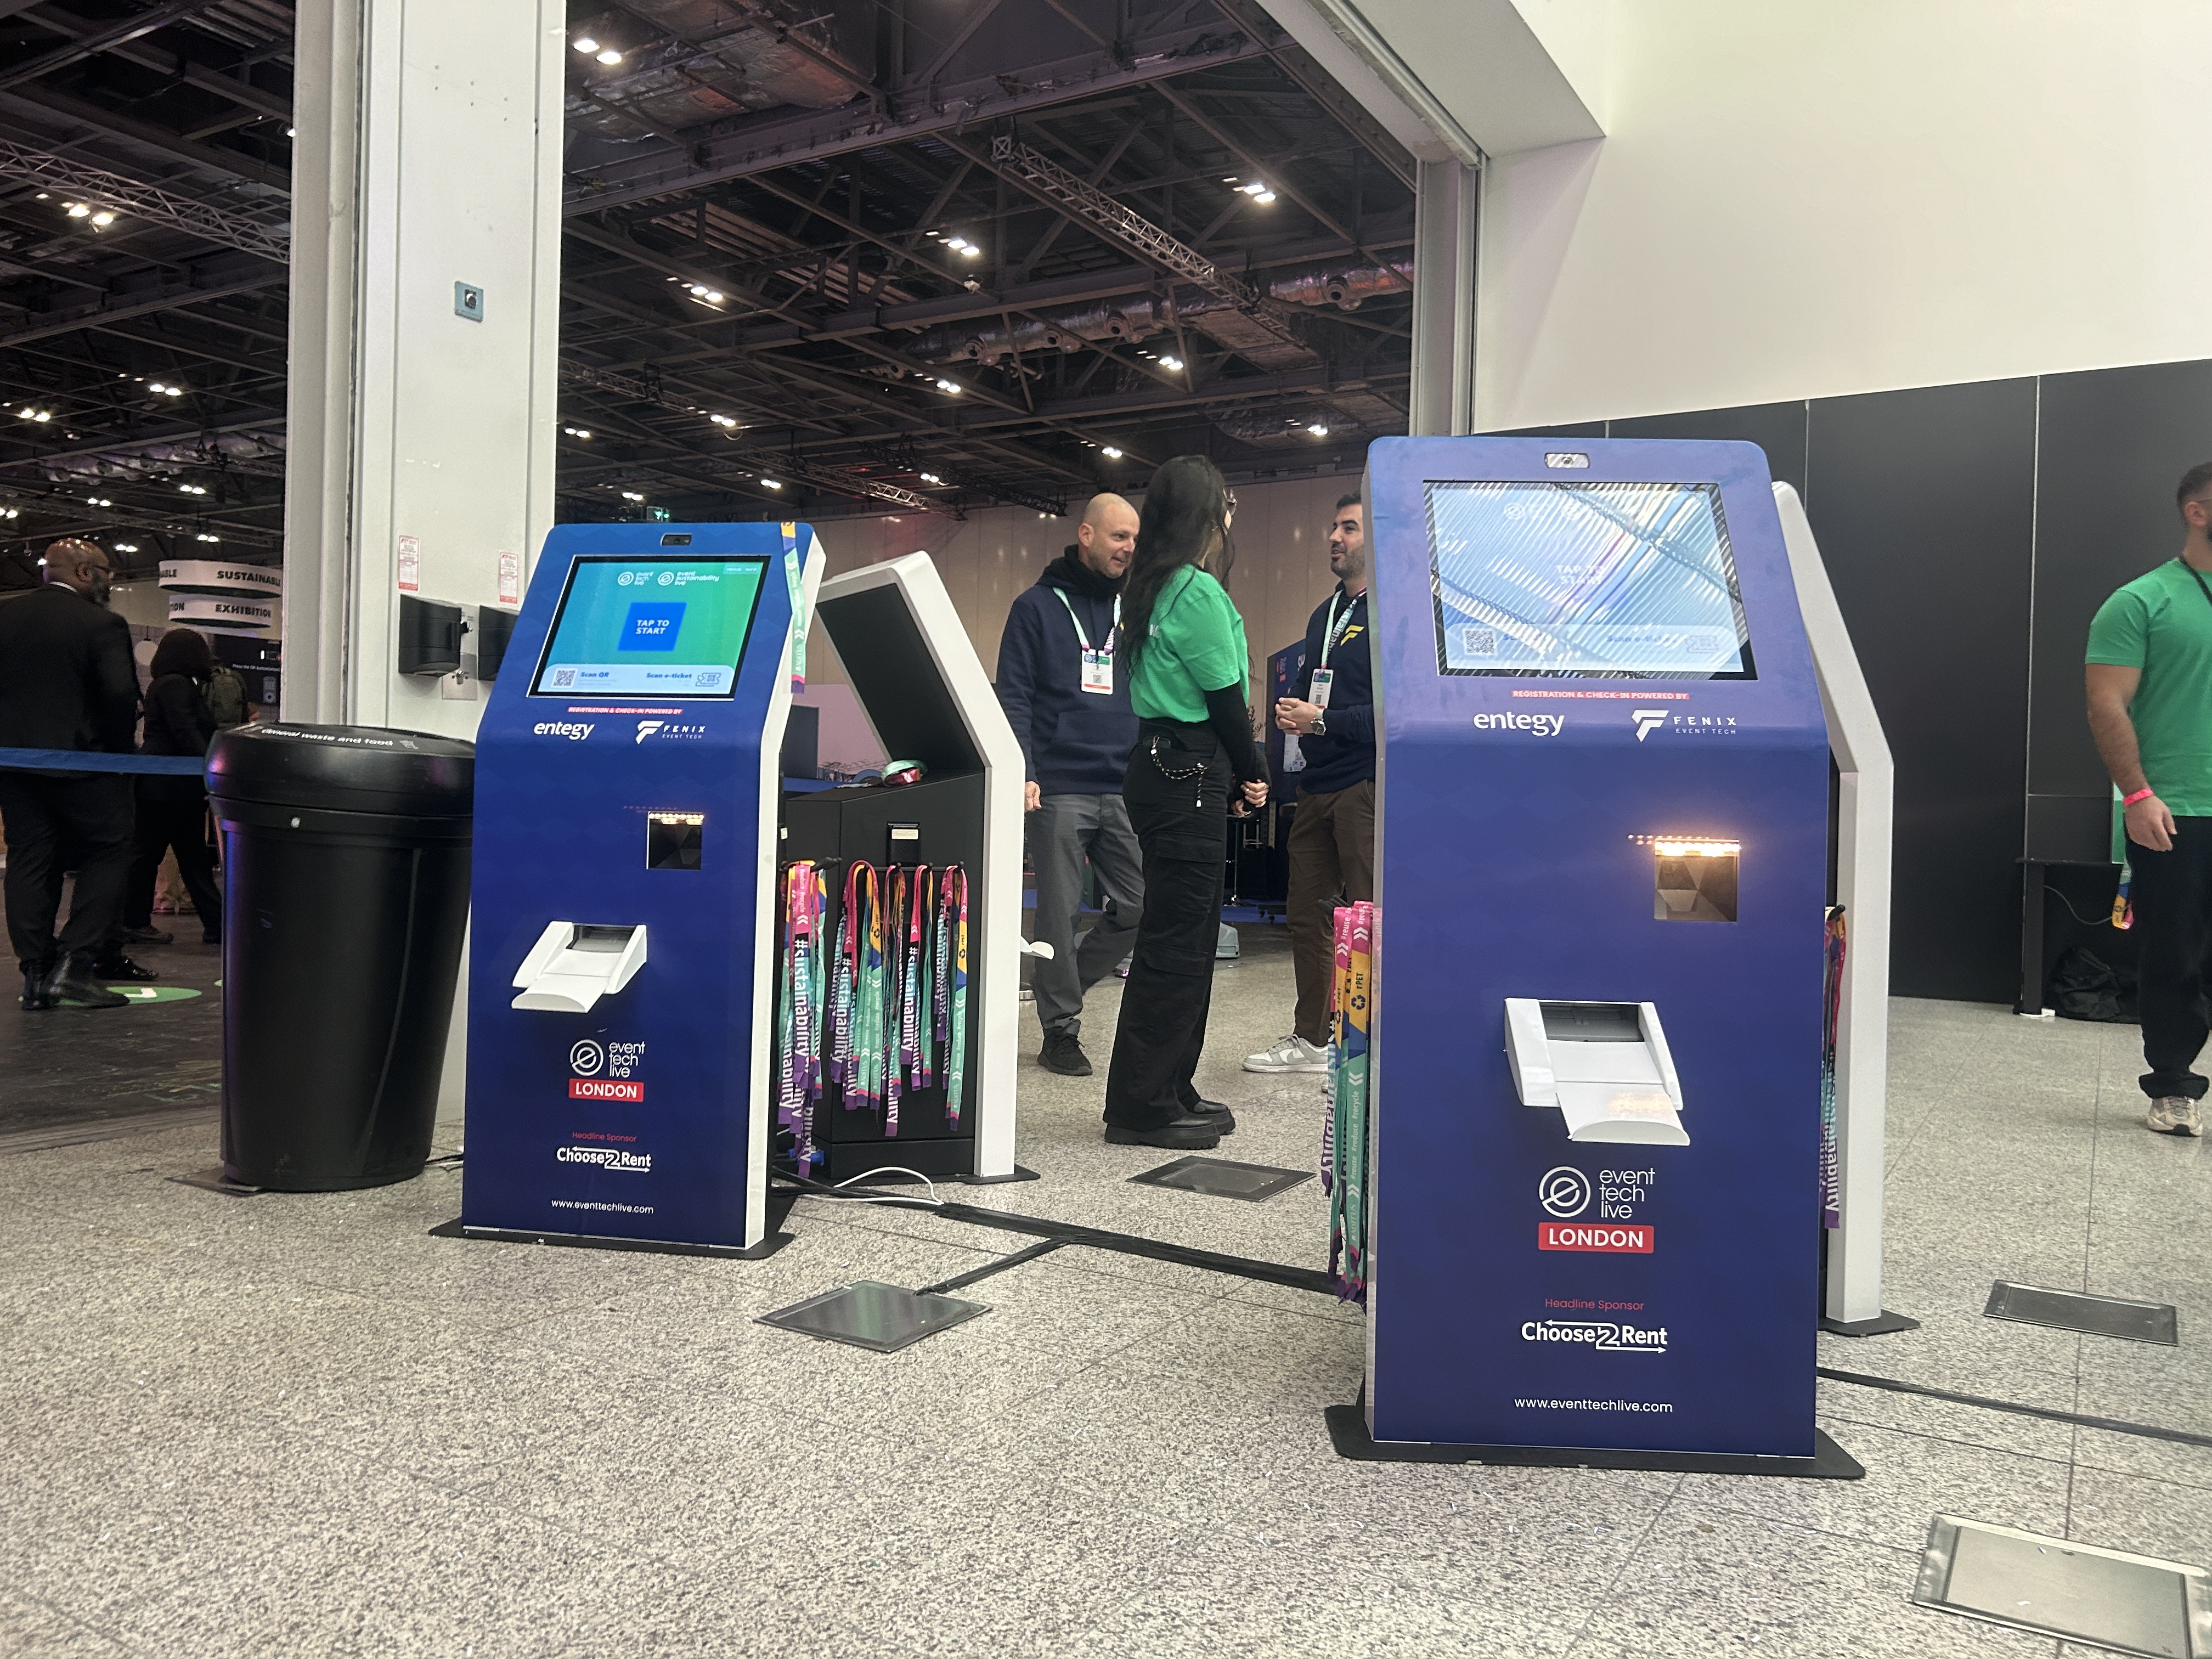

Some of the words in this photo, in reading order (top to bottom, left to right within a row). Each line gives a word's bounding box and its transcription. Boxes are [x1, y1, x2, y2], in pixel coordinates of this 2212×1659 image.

[217, 570, 281, 586] SUSTAINABL
[1512, 690, 1575, 698] REGISTRATION
[1631, 691, 1674, 700] POWERED
[1473, 712, 1565, 737] entegy
[1673, 715, 1737, 726] FENIX
[534, 721, 596, 740] entegy
[663, 725, 706, 733] FENIX
[302, 733, 335, 742] waste
[337, 736, 361, 744] and
[365, 738, 393, 747] food
[1340, 917, 1351, 940] #reuse
[794, 939, 810, 1057] #sustainability
[901, 946, 918, 1052] #sustainability
[832, 957, 853, 1064] #sustainability
[609, 1040, 646, 1054] event
[609, 1052, 639, 1067] tech
[609, 1064, 630, 1078] live
[575, 1082, 638, 1099] LONDON
[1351, 1090, 1360, 1120] #recycle
[572, 1131, 605, 1141] Headline
[606, 1133, 637, 1143] Sponsor
[1599, 1167, 1656, 1186] event
[1599, 1184, 1645, 1203] tech
[551, 1198, 654, 1214] www.eventtechlive.com
[1600, 1200, 1633, 1220] live
[1548, 1228, 1644, 1248] LONDON
[1545, 1298, 1595, 1310] Headline
[1598, 1299, 1645, 1312] Sponsor
[1514, 1397, 1673, 1413] www.eventtechlive.com
